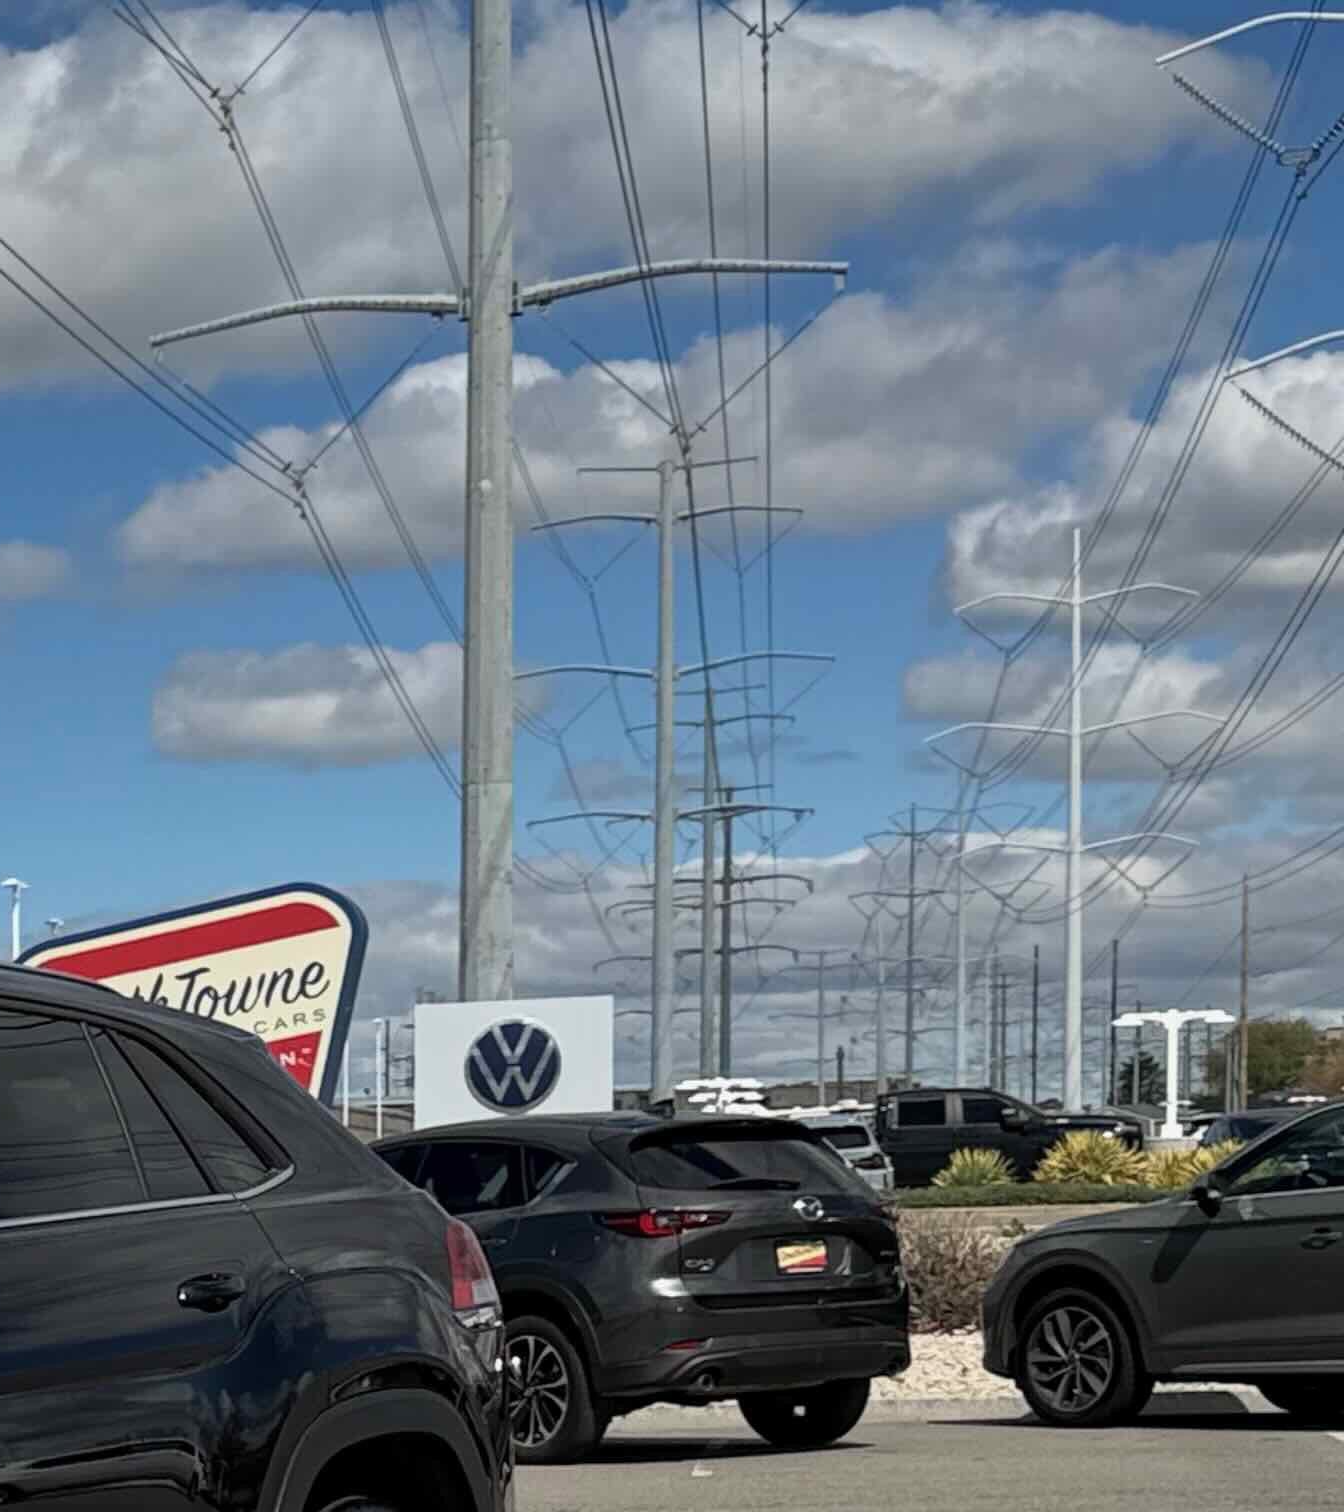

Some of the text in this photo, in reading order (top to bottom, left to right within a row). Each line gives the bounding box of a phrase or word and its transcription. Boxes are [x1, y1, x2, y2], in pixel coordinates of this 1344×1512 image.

[176, 960, 331, 1019] Towne
[253, 1008, 327, 1034] CARS
[467, 1020, 558, 1109] VW
